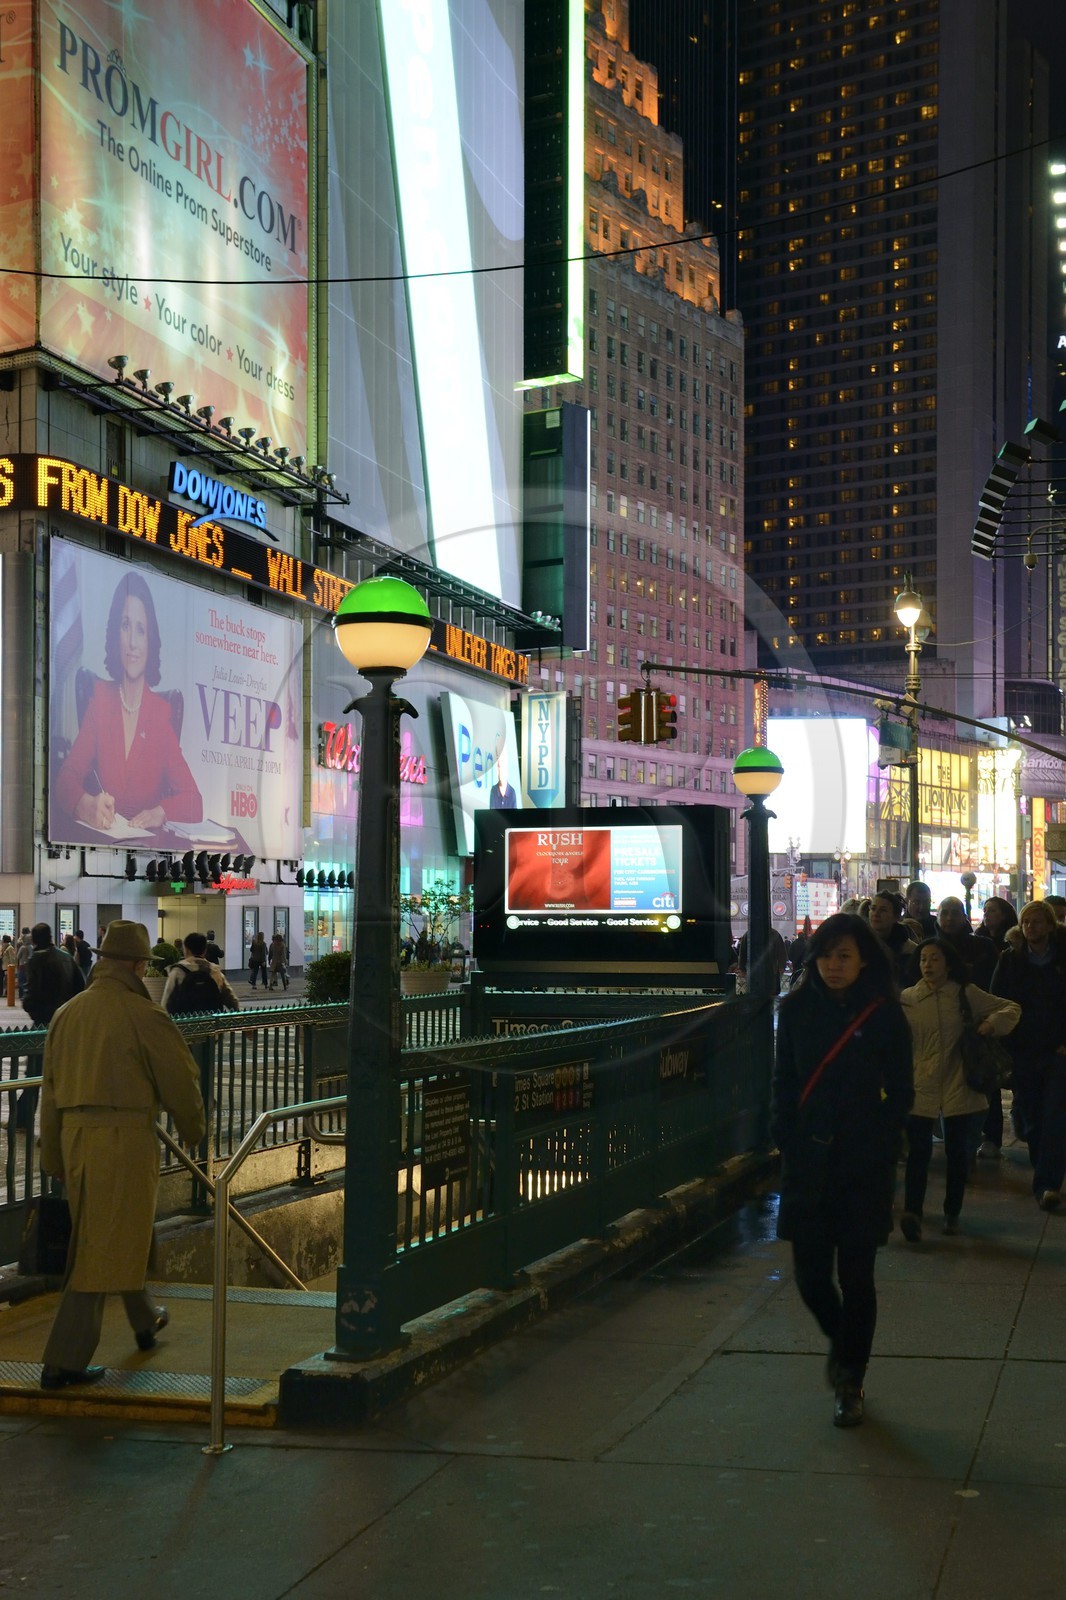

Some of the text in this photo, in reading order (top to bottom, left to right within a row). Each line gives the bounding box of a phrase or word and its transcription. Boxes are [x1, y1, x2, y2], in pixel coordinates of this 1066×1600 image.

[57, 18, 298, 255] PROMGIRL.COM
[97, 118, 272, 272] The Online Prom Superstore
[60, 232, 295, 401] Your style Your color Your dress
[38, 458, 108, 524] FROM
[118, 485, 161, 544] DOW
[267, 548, 306, 601] WALL
[208, 608, 266, 648] The buck stops
[195, 631, 279, 666] somewhere near here.
[491, 642, 516, 680] TAKES
[212, 665, 228, 681] Julia
[195, 683, 282, 753] VEEP
[201, 749, 233, 766] SUNDAY,
[234, 756, 255, 770] APRIL
[265, 760, 282, 775] 10PM
[538, 700, 550, 788] NYPD
[937, 765, 950, 780] THE
[231, 791, 258, 819] HBO
[537, 833, 583, 850] RUSH
[1034, 828, 1043, 877] Kodak
[547, 917, 568, 926] Good
[570, 917, 598, 926] Service
[607, 917, 628, 926] Good
[630, 917, 659, 926] Service
[532, 1071, 554, 1090] Square
[521, 1092, 529, 1110] St
[531, 1089, 553, 1108] Station
